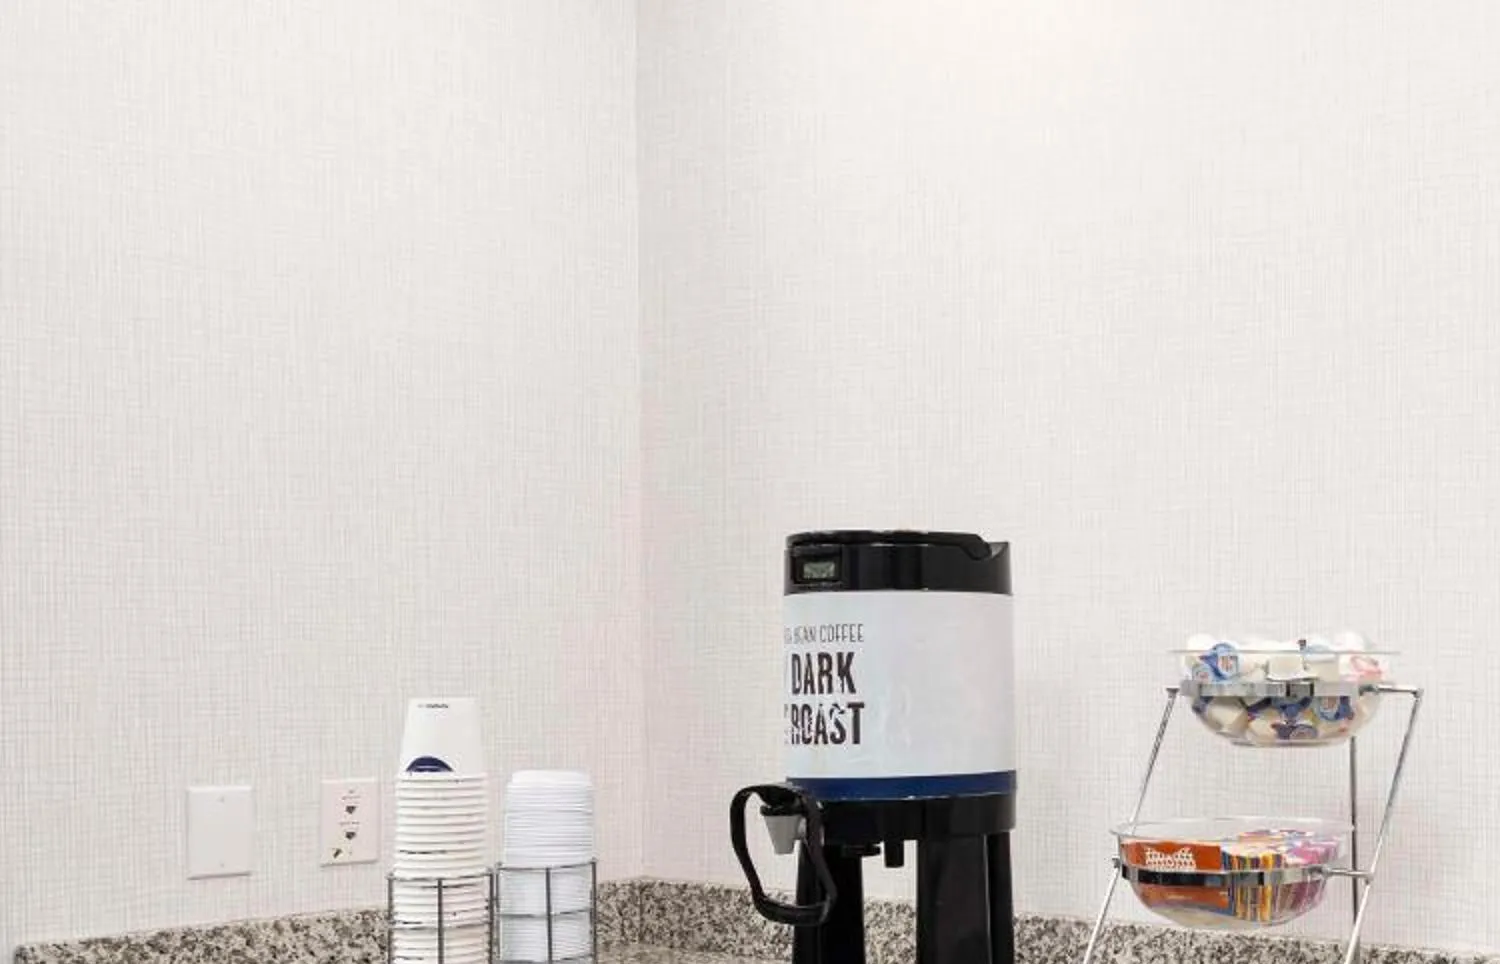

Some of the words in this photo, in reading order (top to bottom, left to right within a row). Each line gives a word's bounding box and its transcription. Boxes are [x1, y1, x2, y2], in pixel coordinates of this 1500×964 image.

[819, 623, 864, 642] COFFEE
[791, 651, 856, 695] DARK
[791, 702, 865, 745] ROAST
